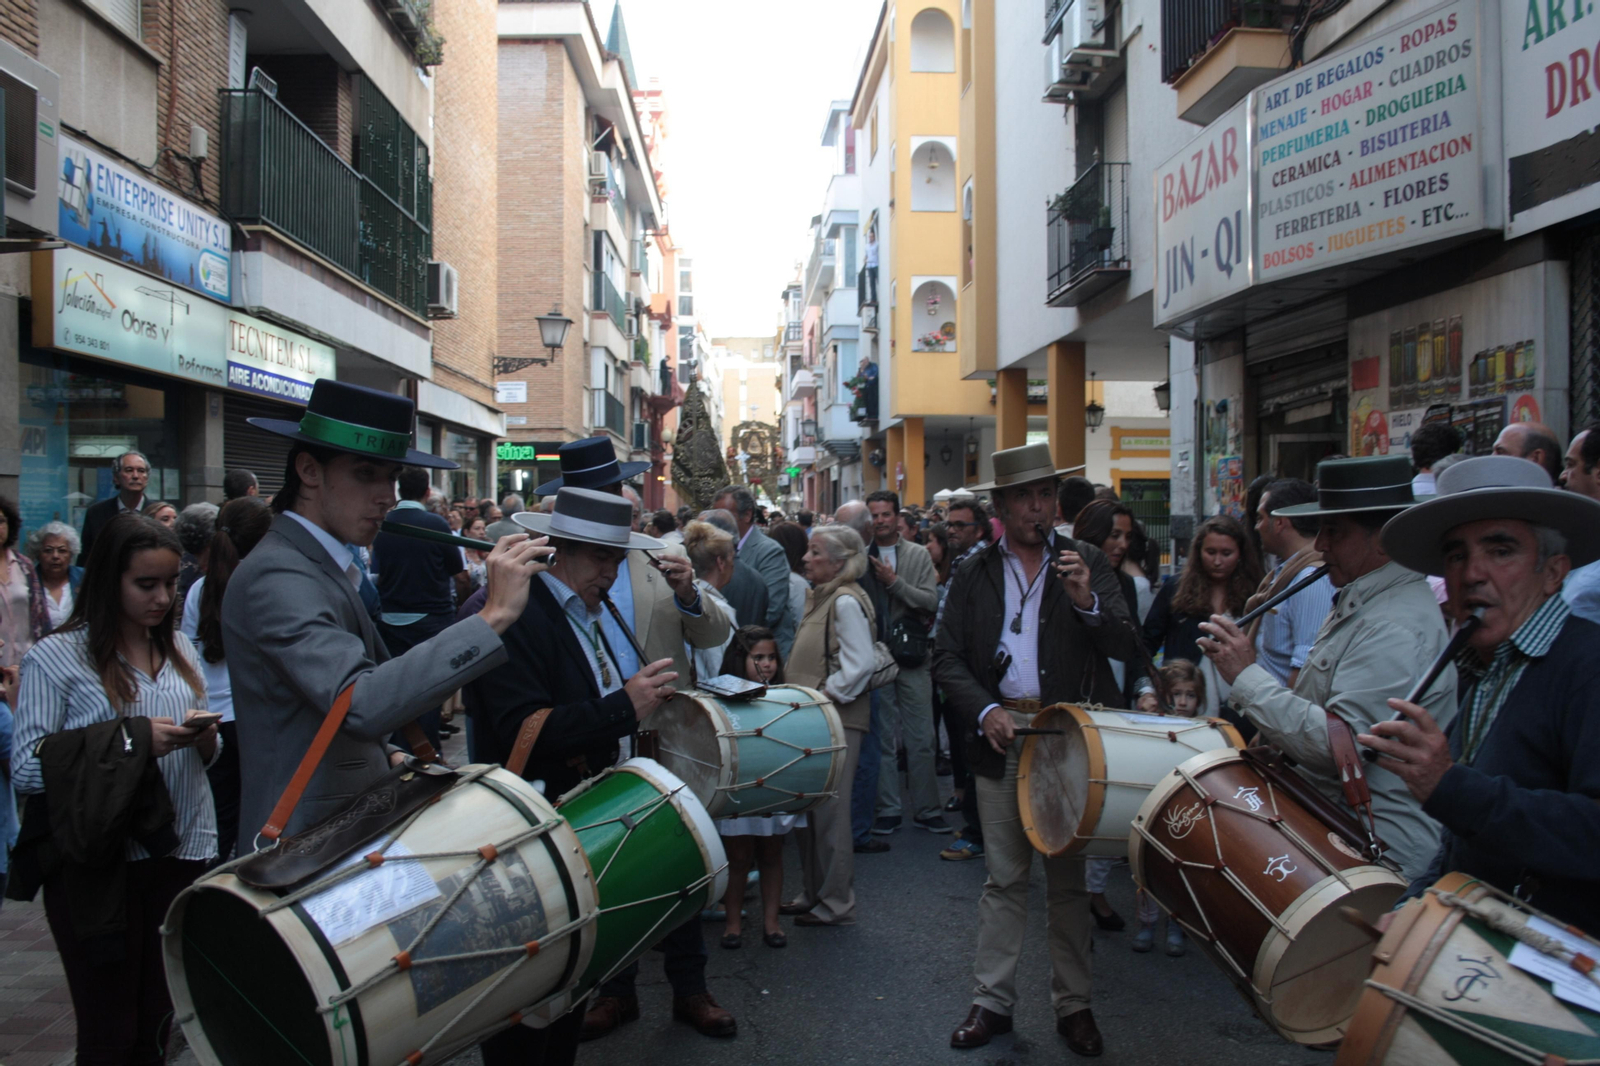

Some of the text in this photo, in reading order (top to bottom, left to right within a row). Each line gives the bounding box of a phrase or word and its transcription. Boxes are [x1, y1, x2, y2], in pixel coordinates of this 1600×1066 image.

[1258, 38, 1472, 141] MENAJE HOGAR CUADROS
[1264, 12, 1458, 113] ART. DE REGALOS ROPAS
[1261, 73, 1467, 167] PERFUMERIA DROGUERIA
[1272, 110, 1451, 188] CERAMICA BISUTERIA
[96, 163, 174, 226] ENTERPRISE
[177, 205, 211, 243] UNITY
[1163, 126, 1239, 223] BAZAR
[1259, 133, 1473, 219] PLASTICOS ALIMENTACION
[1275, 172, 1449, 240] FERRETERIA FLORES
[96, 197, 200, 250] EMPRESA CONSTRUCTORA
[1263, 241, 1315, 270] BOLSOS
[1327, 215, 1406, 253] JUGUETES
[121, 309, 157, 340] Obras
[178, 354, 224, 381] Reformas
[228, 366, 313, 401] AIRE ACONDICIONAD
